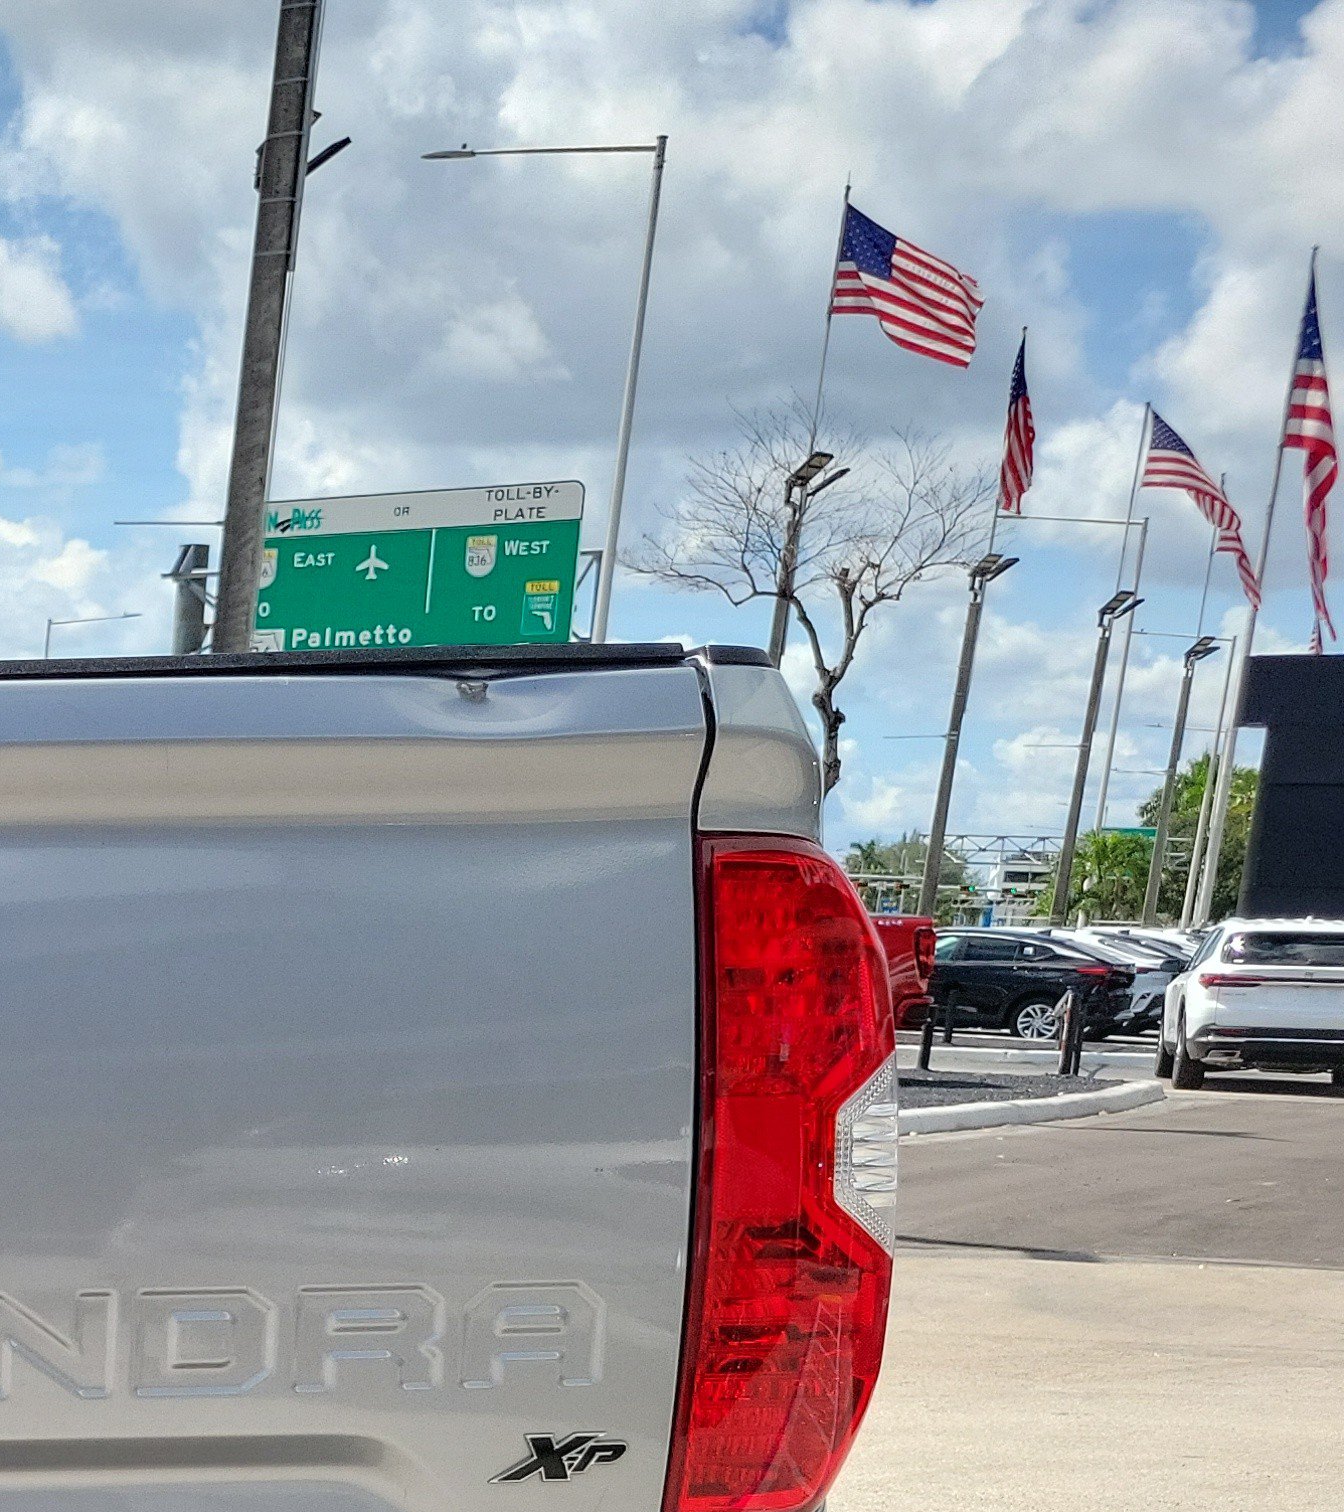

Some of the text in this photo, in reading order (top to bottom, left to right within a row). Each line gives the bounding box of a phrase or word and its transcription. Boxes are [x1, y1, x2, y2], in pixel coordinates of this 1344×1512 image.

[393, 506, 411, 517] OR
[493, 506, 547, 521] PLATE
[504, 540, 551, 556] WEST
[293, 552, 336, 568] EAST
[529, 582, 555, 592] TOLL
[471, 605, 497, 622] TO
[291, 625, 412, 649] Palmetto
